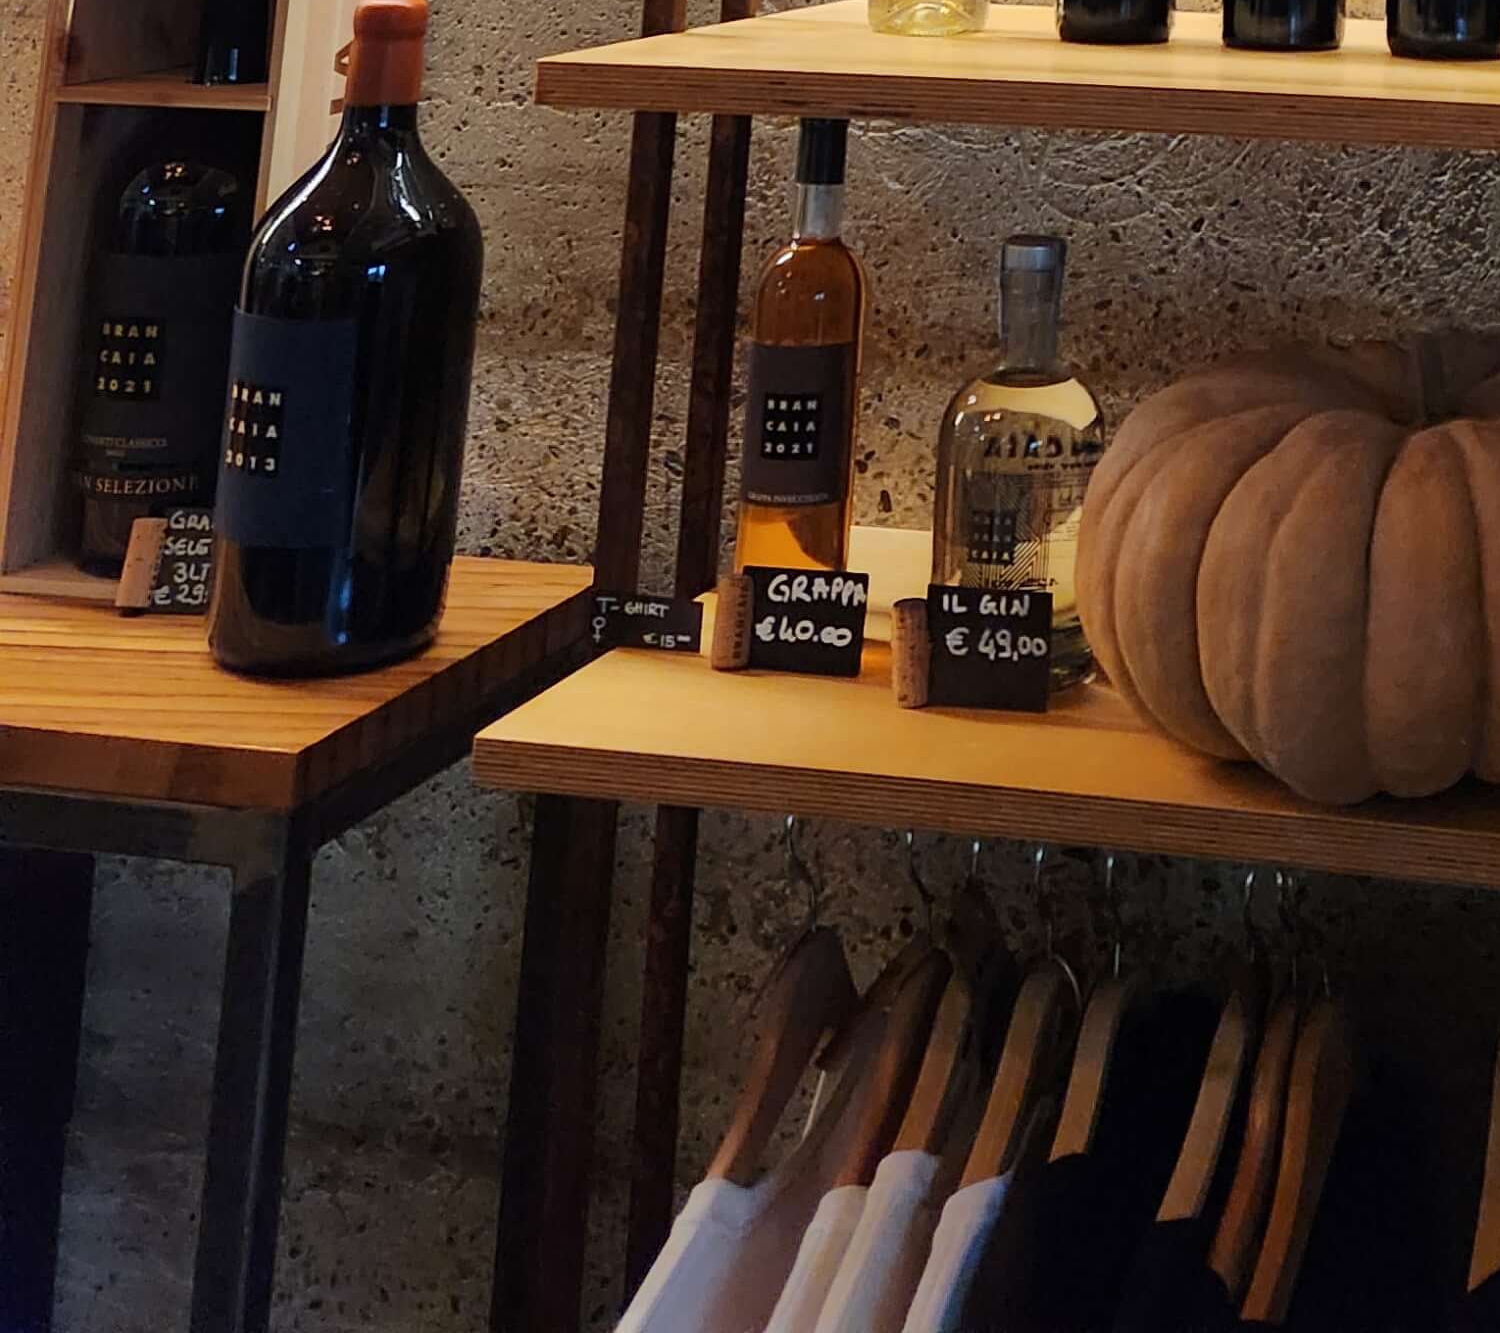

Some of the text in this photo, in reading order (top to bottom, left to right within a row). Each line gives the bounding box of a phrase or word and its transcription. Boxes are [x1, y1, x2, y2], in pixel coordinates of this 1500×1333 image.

[102, 323, 159, 339] BRAN
[101, 349, 156, 366] CAIA
[232, 383, 282, 406] BRAN
[767, 398, 818, 411] BRAN
[766, 420, 816, 433] CAIA
[765, 442, 814, 454] 2021
[767, 574, 867, 608] GRAPPA
[942, 594, 1030, 618] IL GIN
[945, 627, 1048, 662] € 49,00
